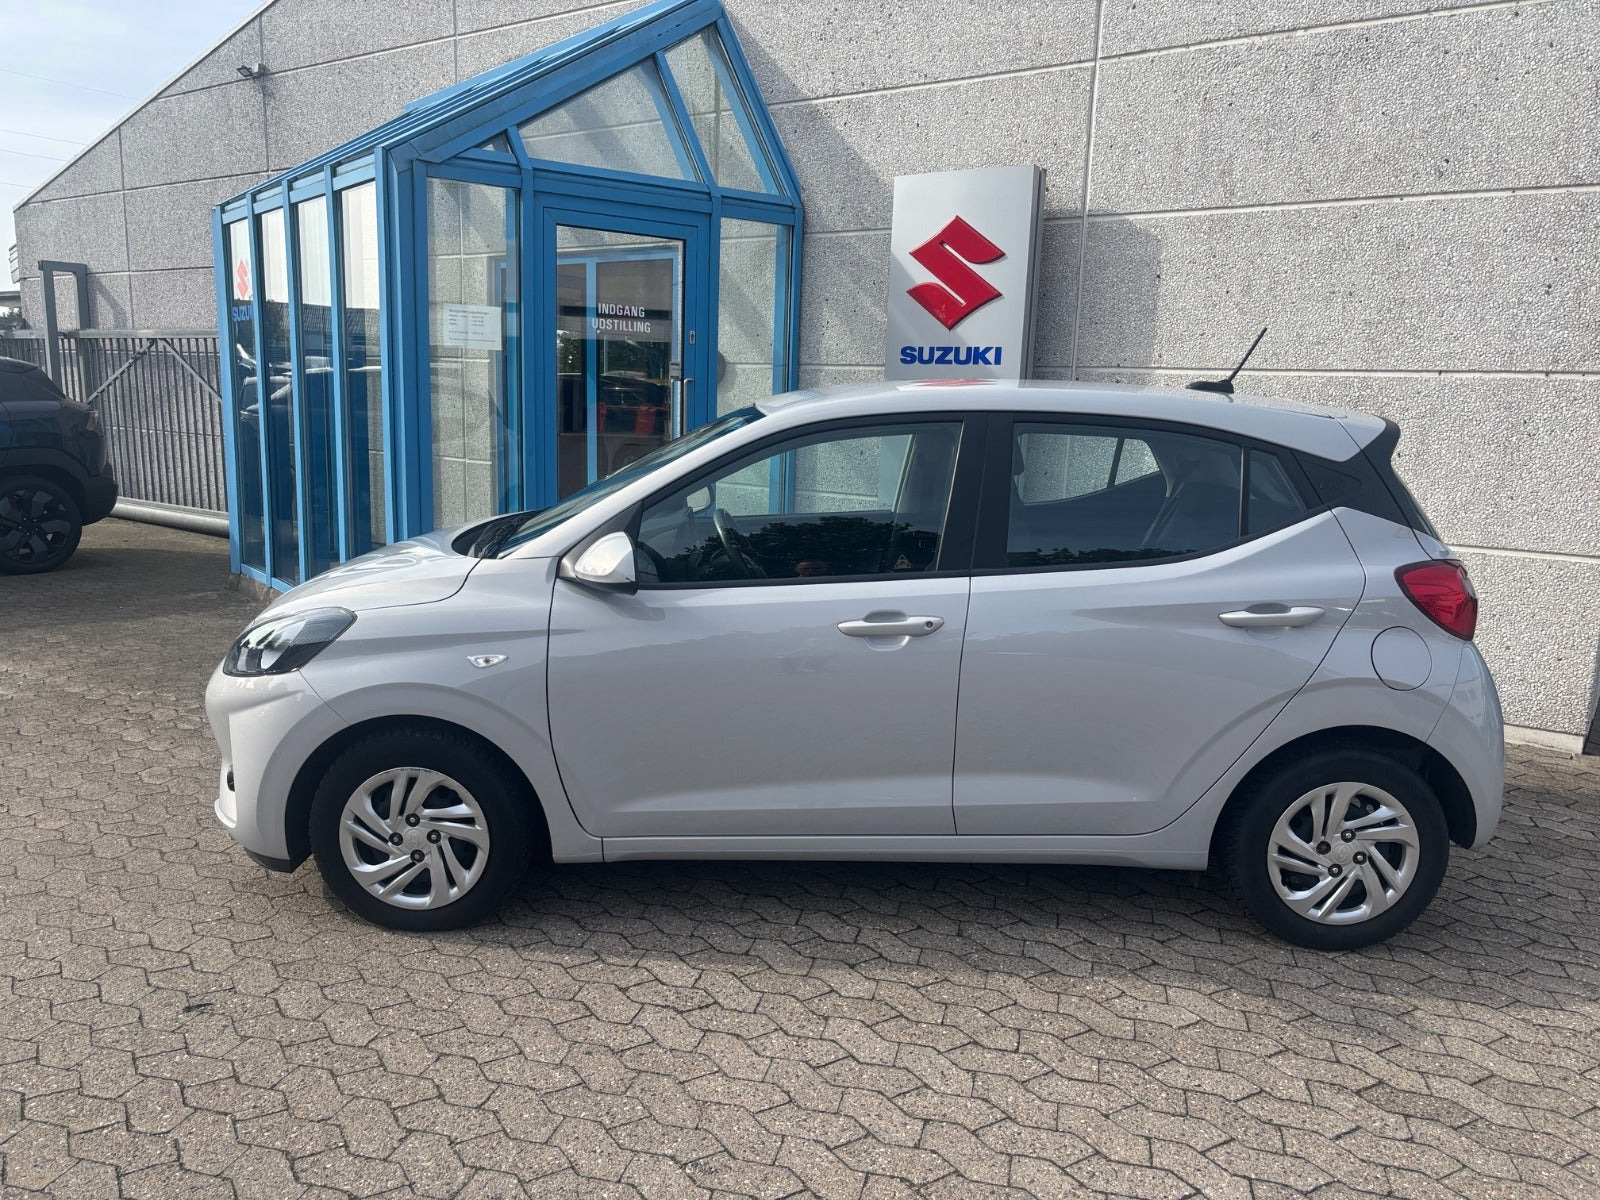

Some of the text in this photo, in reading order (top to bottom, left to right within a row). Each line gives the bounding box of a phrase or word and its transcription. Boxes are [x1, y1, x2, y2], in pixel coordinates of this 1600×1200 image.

[598, 303, 645, 318] INDGANG
[592, 317, 651, 333] UDSTILLING
[900, 345, 1003, 366] SUZUKI
